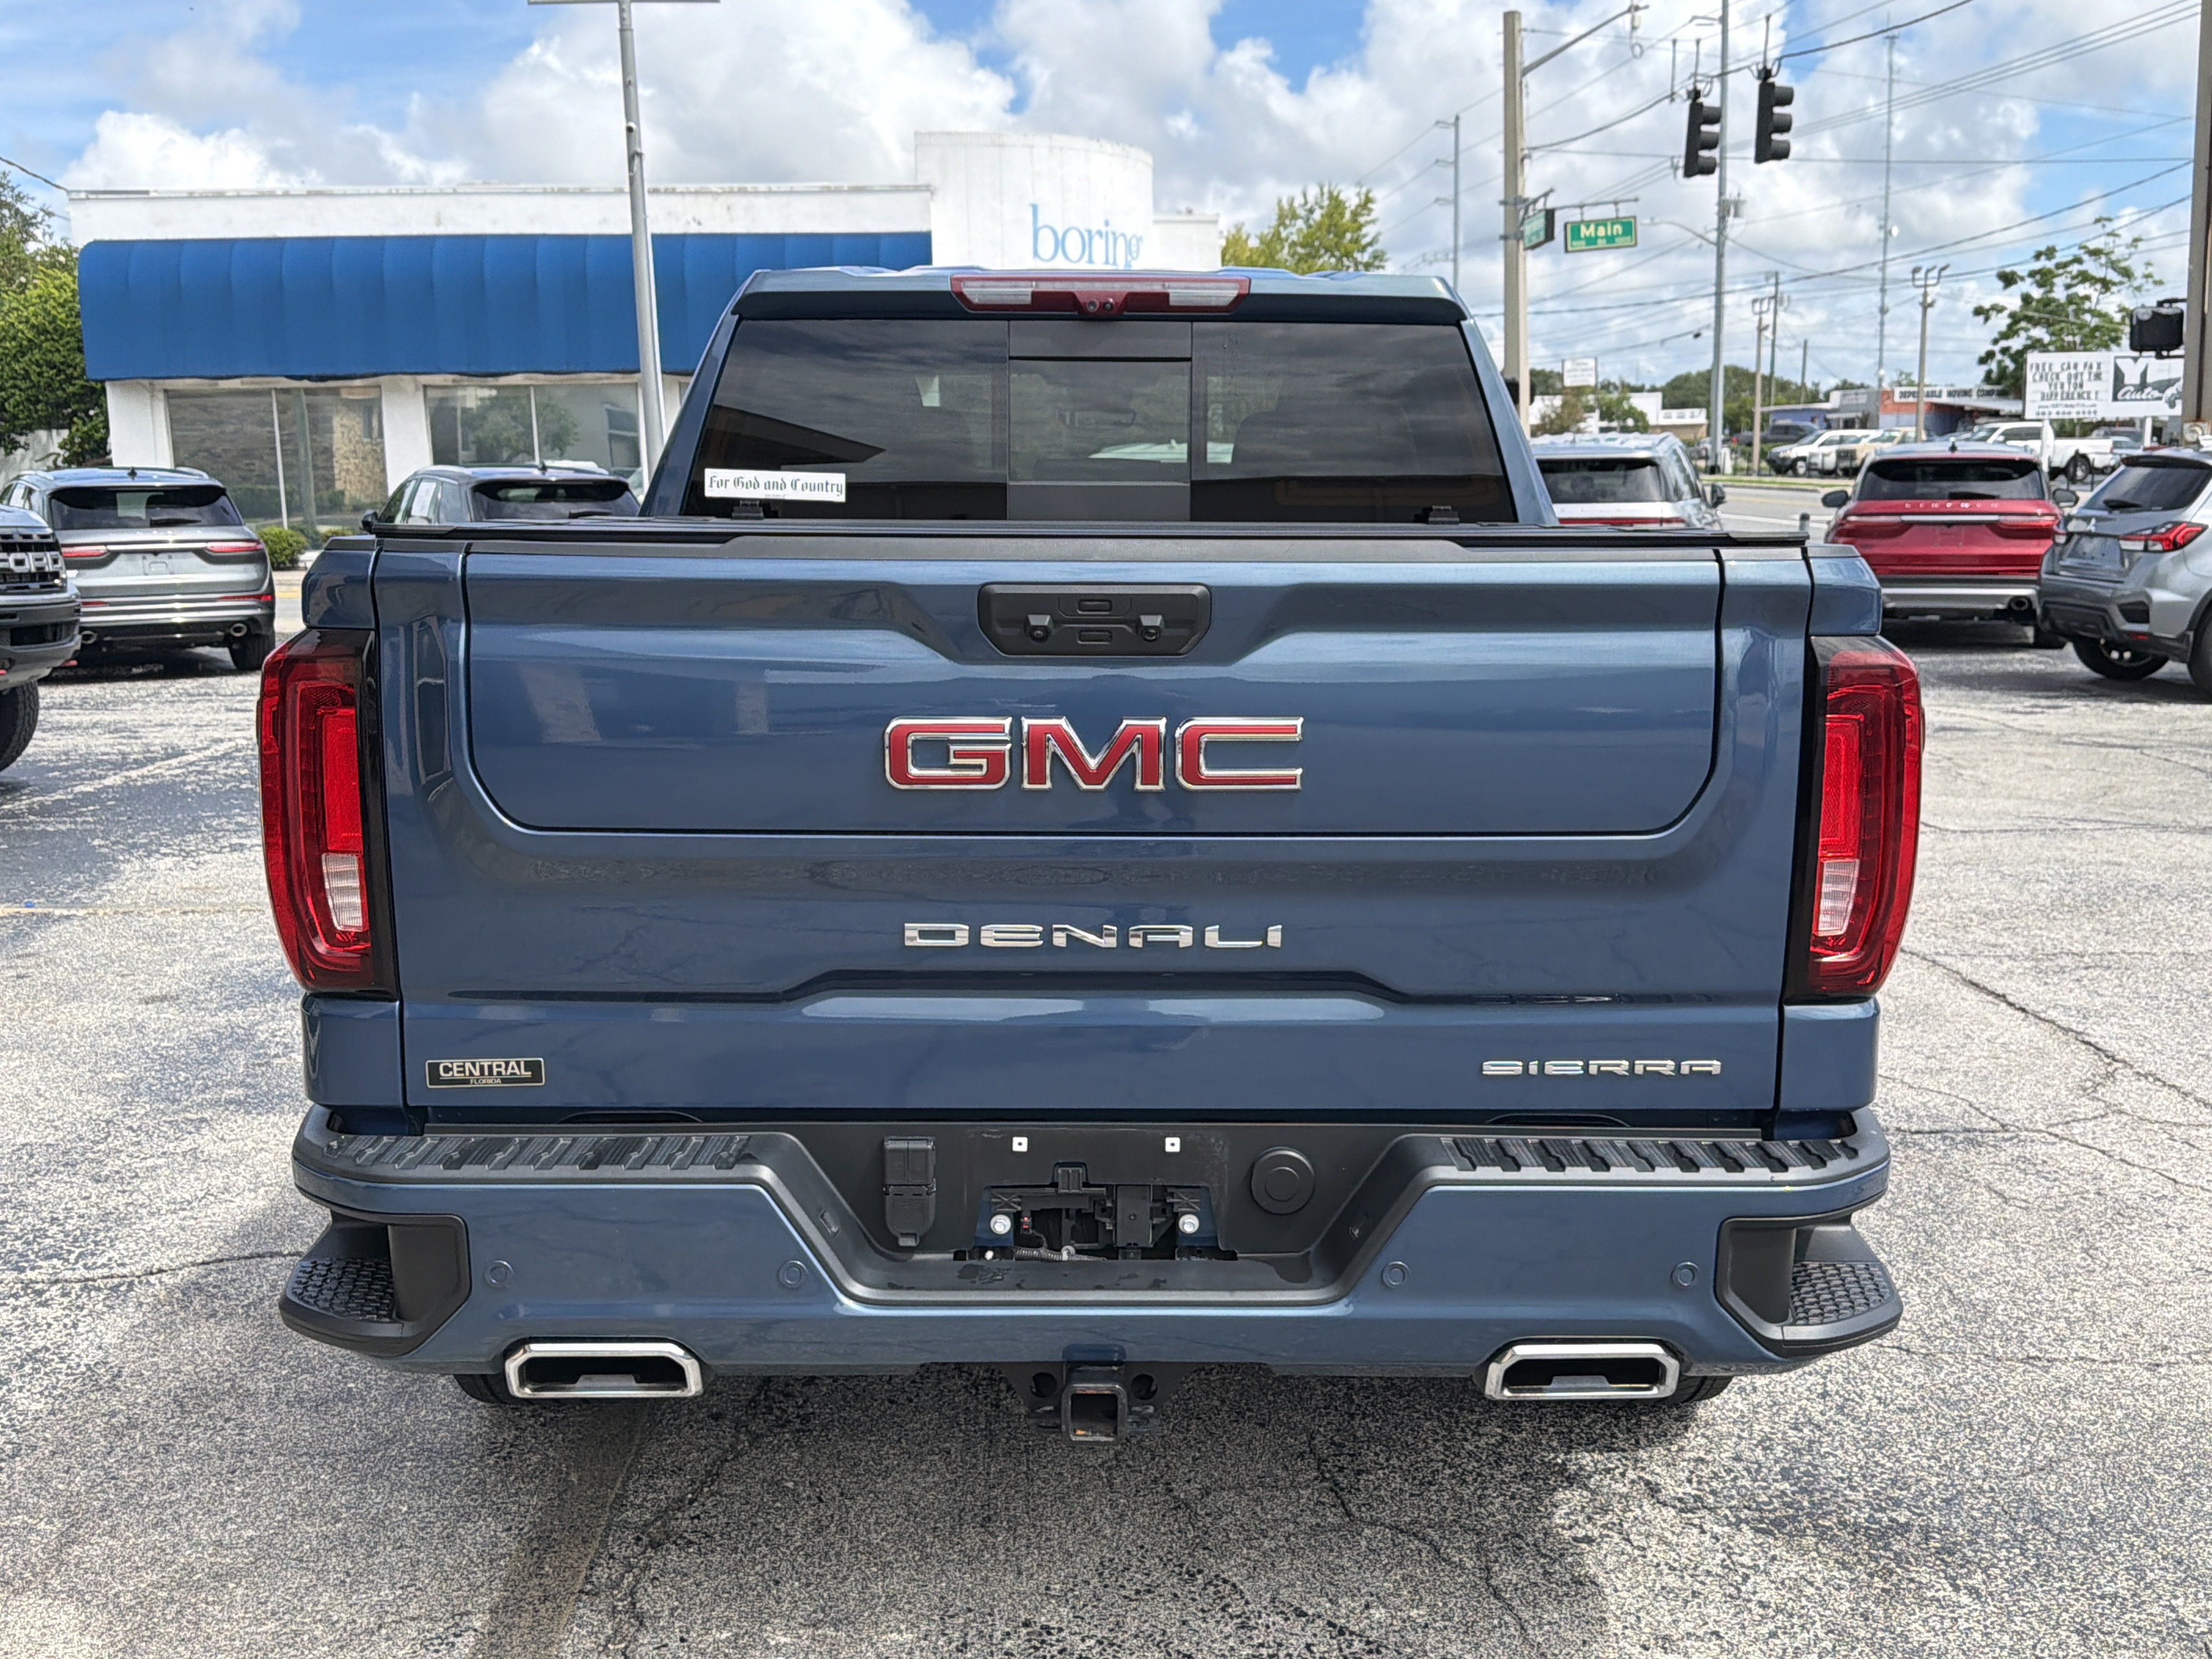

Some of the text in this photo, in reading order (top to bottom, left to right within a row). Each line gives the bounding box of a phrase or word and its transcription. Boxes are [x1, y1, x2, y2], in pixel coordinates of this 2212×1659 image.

[1029, 203, 1142, 269] boring
[1580, 222, 1623, 238] Main
[709, 475, 843, 496] For God and Country
[884, 716, 1305, 792] GMC
[904, 923, 1283, 948] DENALI
[439, 1060, 532, 1077] CENTRAL
[1482, 1059, 1722, 1076] SIERRA
